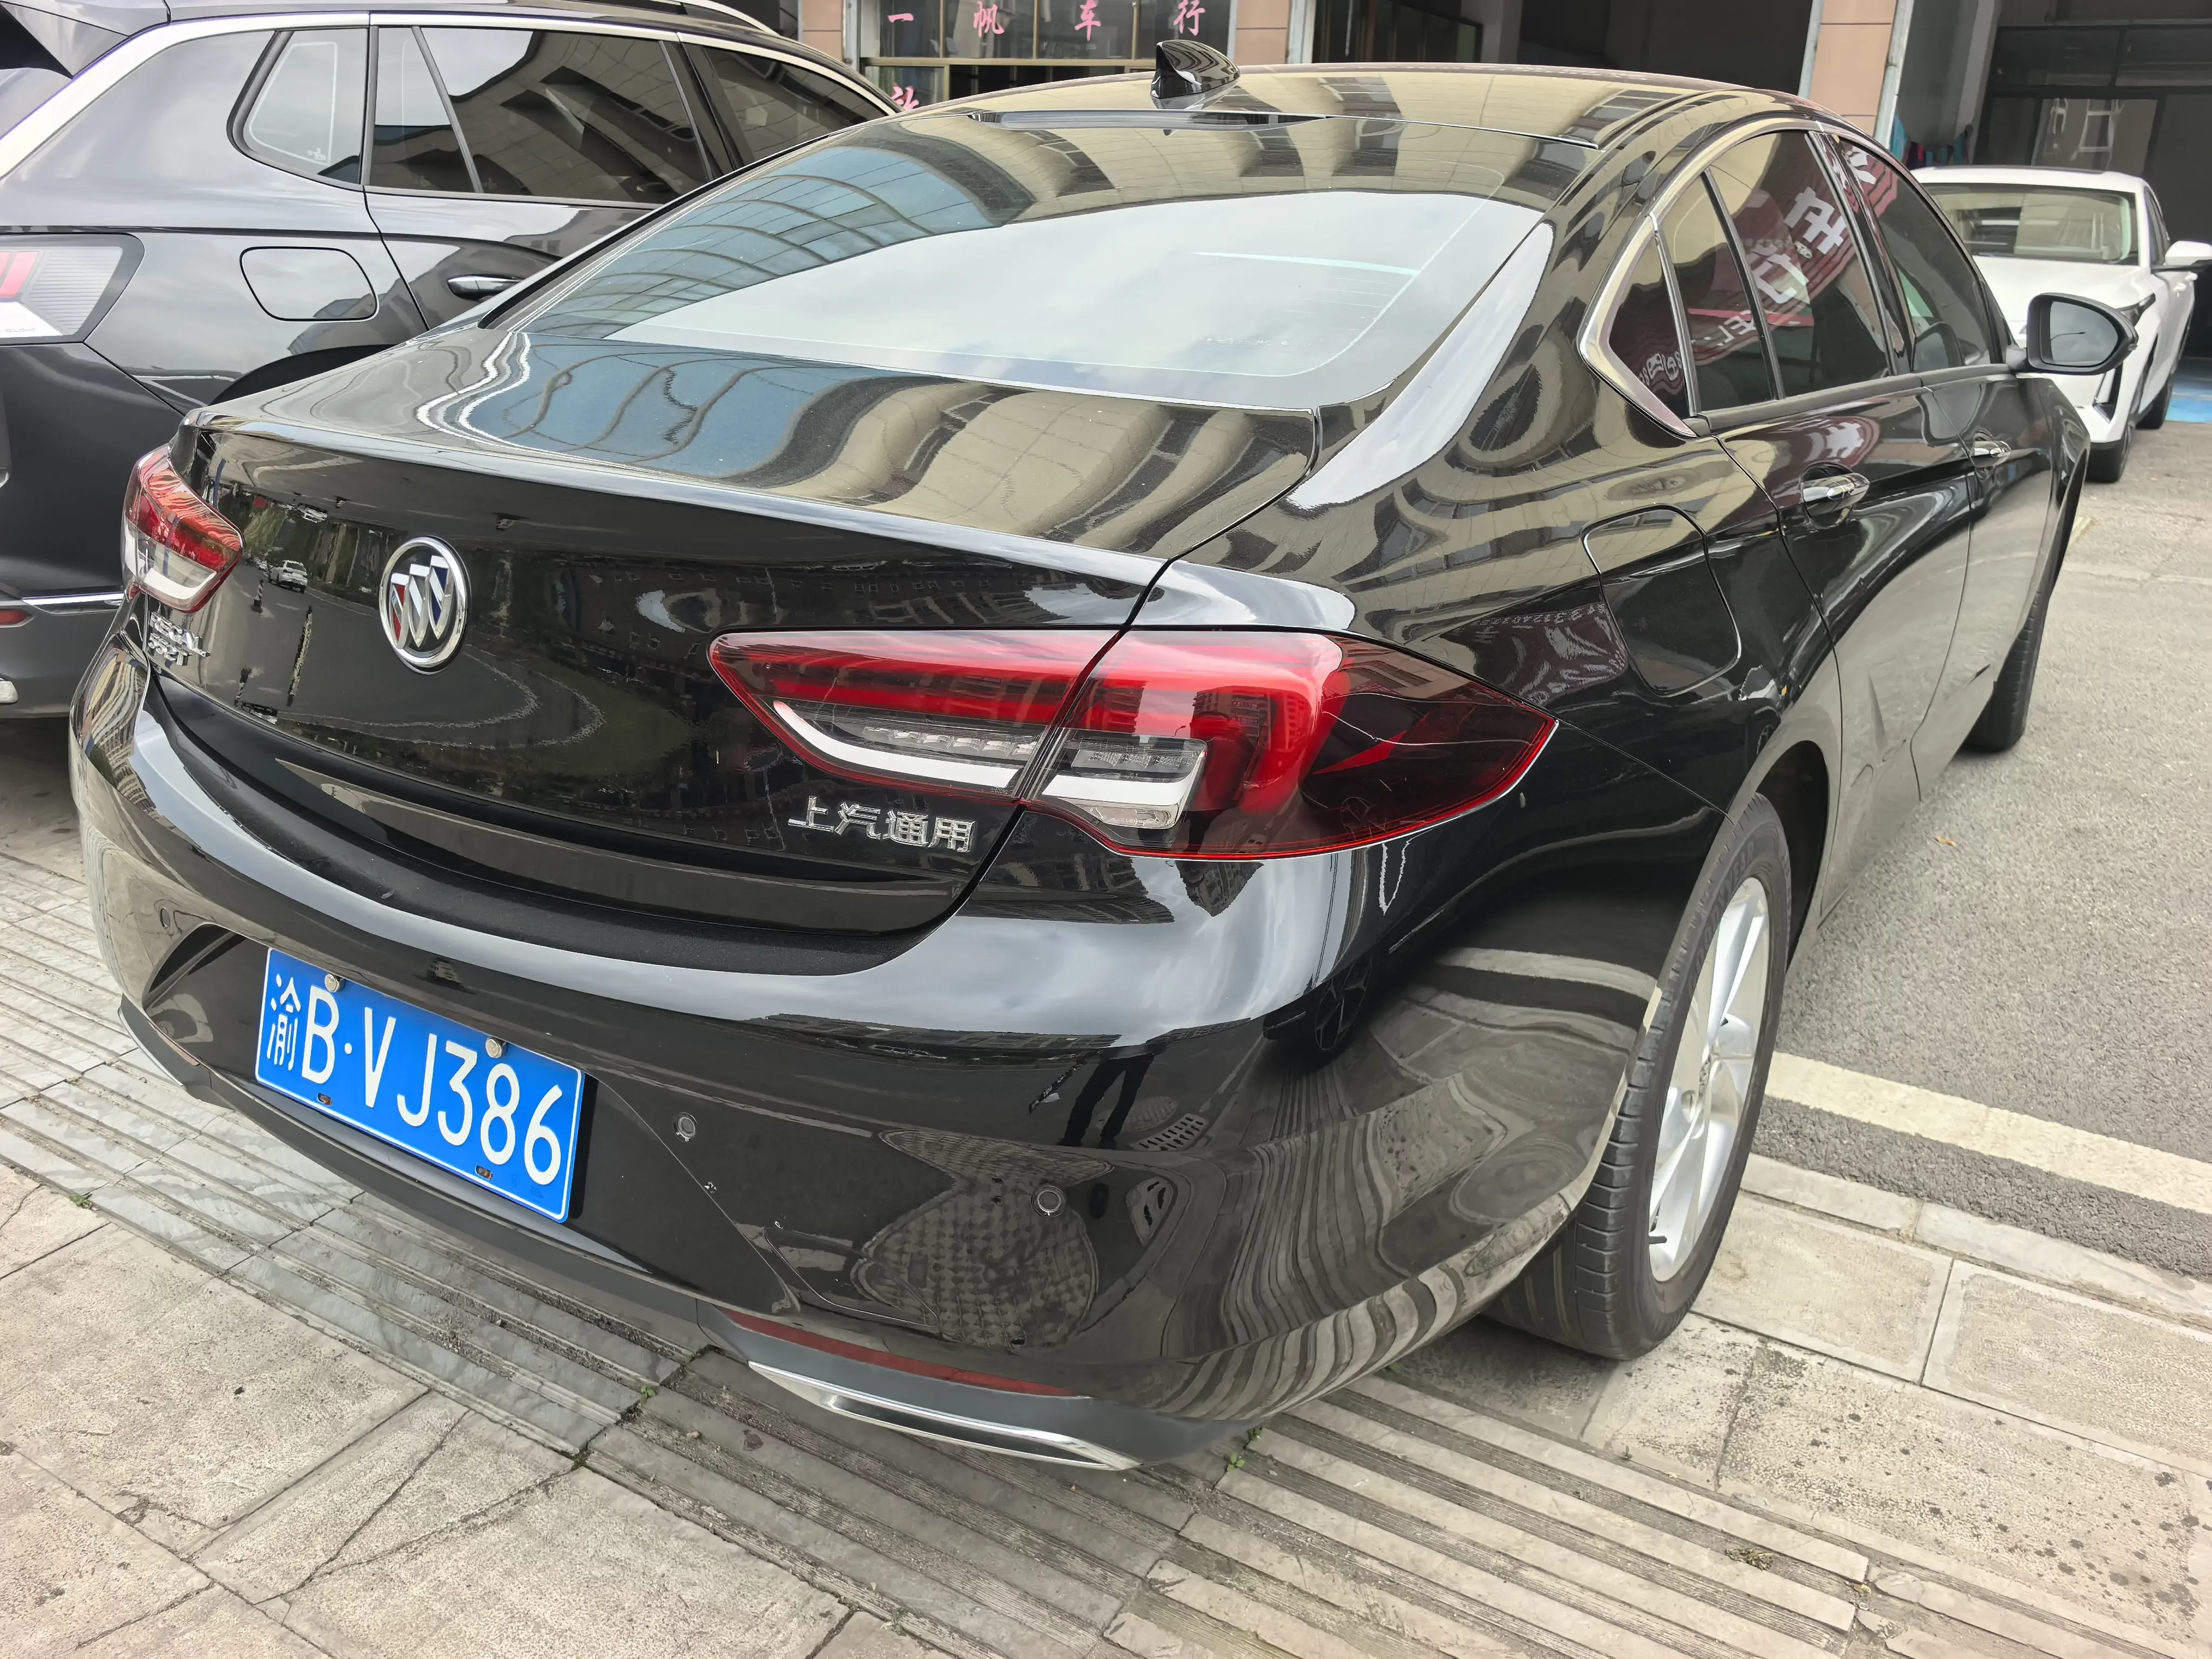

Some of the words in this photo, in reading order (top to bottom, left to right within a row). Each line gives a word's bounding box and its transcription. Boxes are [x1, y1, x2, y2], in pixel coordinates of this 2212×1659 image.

[787, 795, 976, 853] 上汽通用
[266, 973, 563, 1185] 渝B·VJ386
